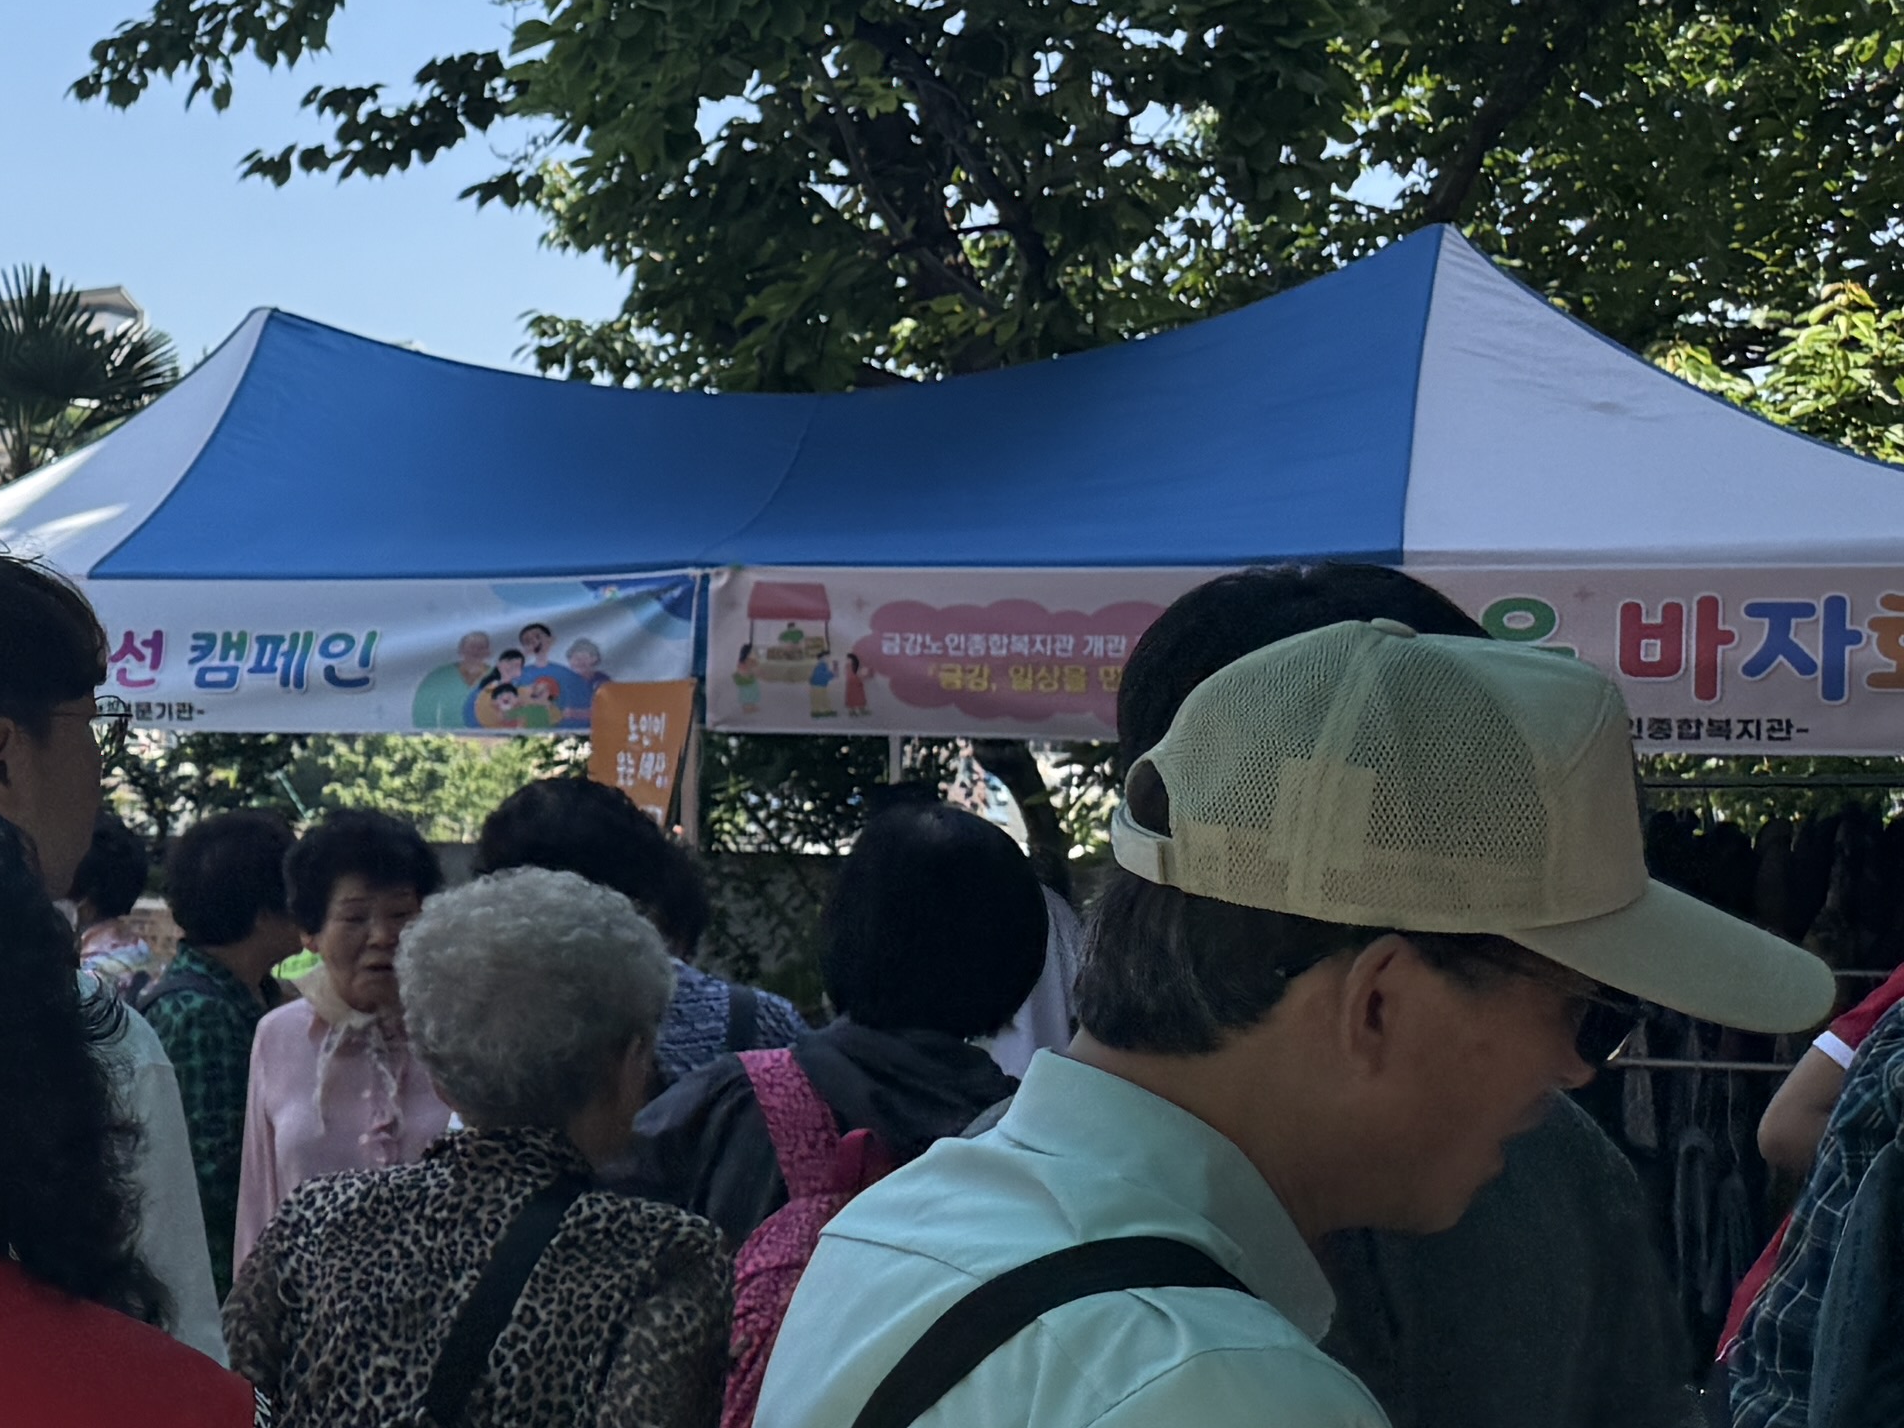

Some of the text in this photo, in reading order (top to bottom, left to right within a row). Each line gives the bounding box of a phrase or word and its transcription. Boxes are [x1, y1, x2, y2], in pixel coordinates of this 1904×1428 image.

[110, 628, 379, 691] 선 캠페인
[881, 632, 1127, 658] 금강노인종합복지관 개관
[1008, 664, 1089, 693] 일상을
